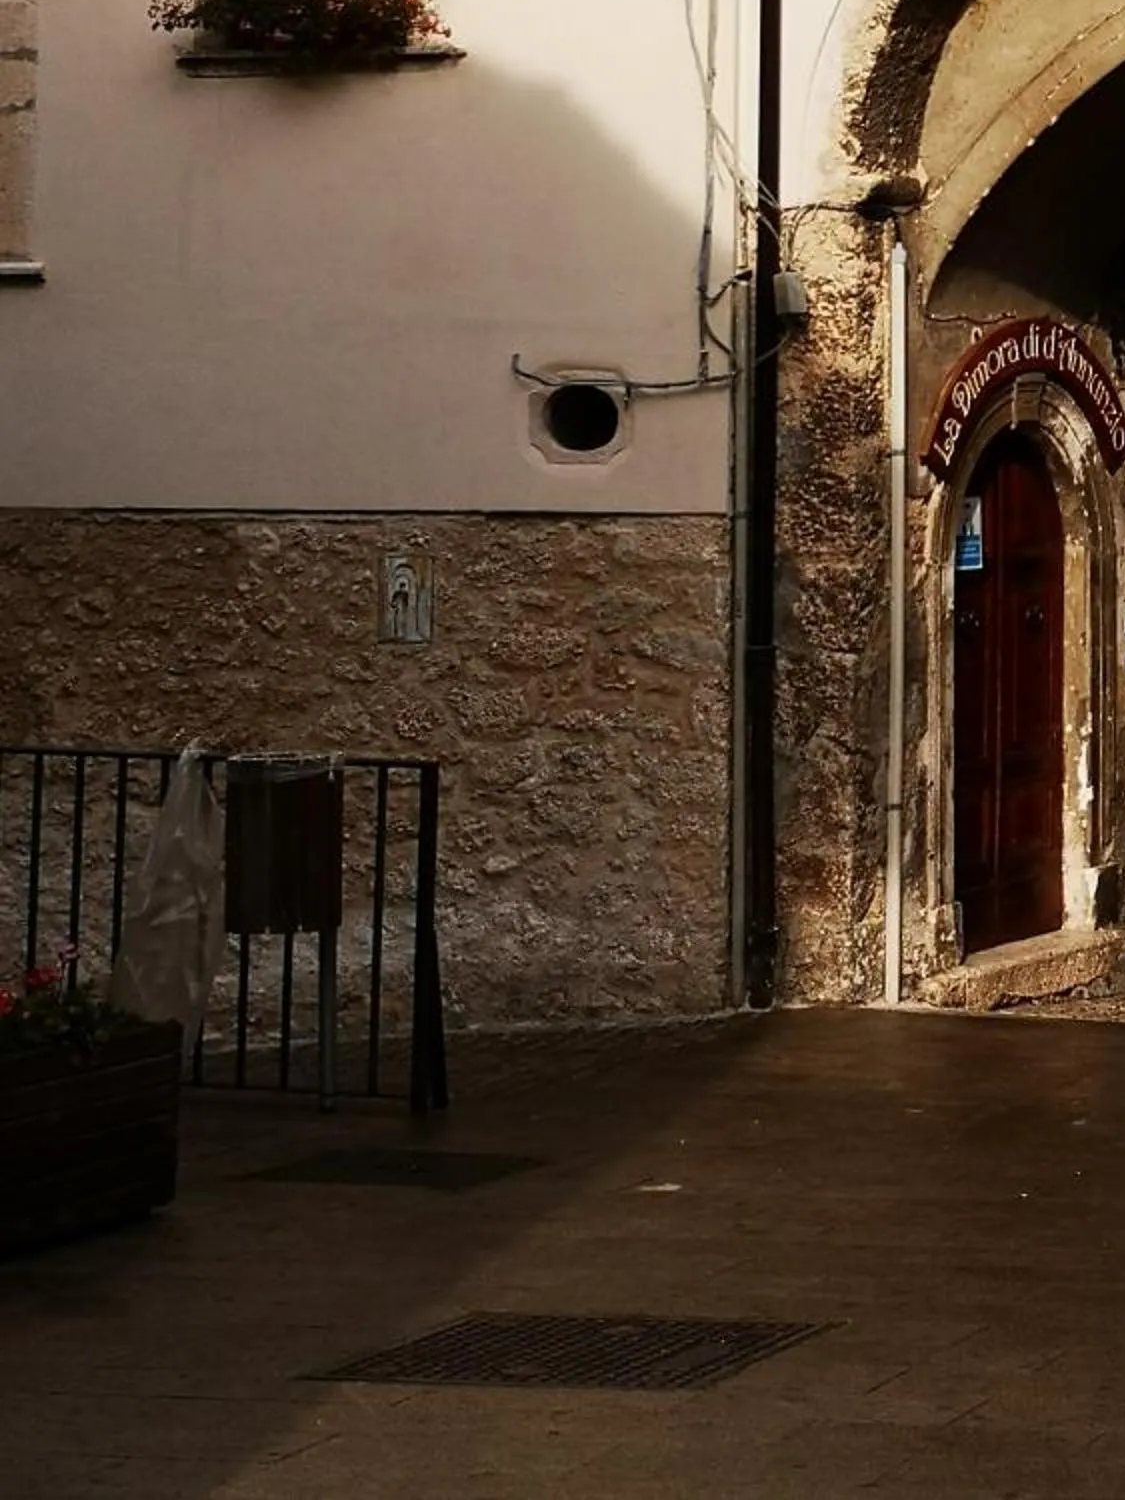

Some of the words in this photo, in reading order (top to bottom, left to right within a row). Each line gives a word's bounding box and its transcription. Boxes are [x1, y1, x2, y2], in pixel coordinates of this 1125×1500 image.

[932, 416, 961, 467] La
[951, 336, 1021, 417] Dimora
[1021, 323, 1041, 360] di
